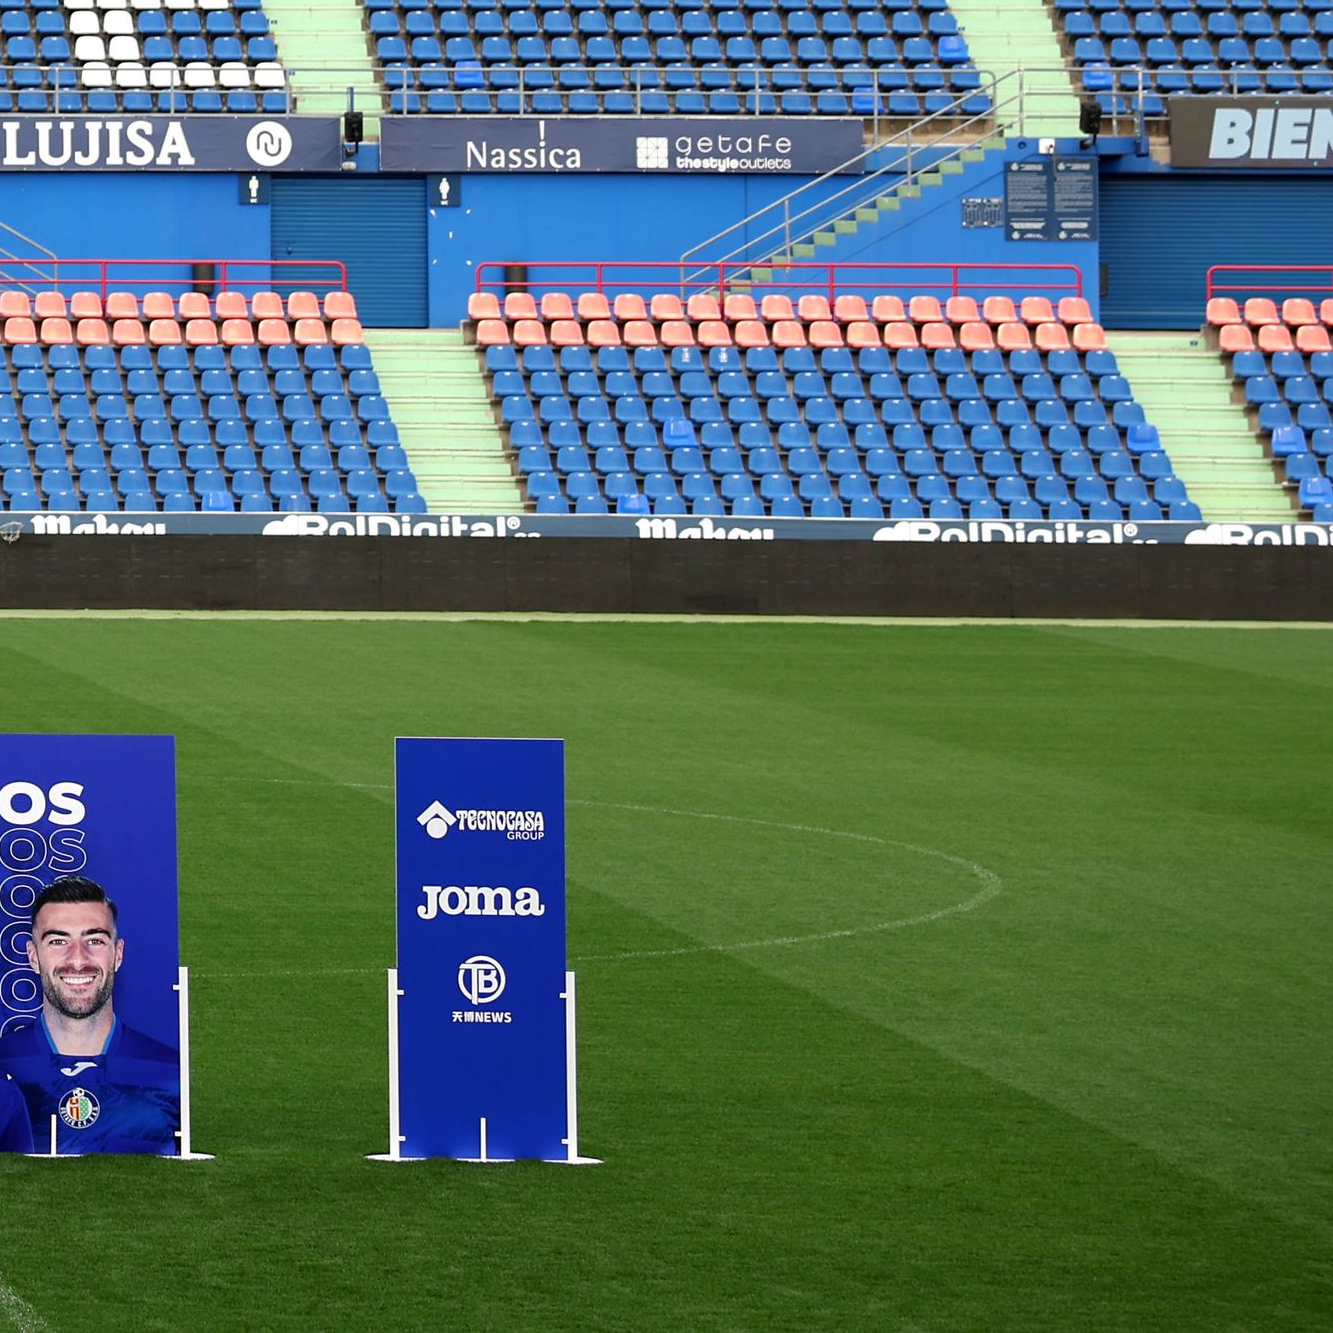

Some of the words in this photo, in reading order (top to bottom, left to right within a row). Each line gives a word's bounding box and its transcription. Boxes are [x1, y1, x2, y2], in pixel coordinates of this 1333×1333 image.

[2, 121, 196, 166] LUJISA
[466, 121, 582, 168] Nassica
[675, 134, 792, 154] getafe
[456, 810, 545, 832] TECNOCASA
[506, 830, 545, 842] GROUP
[416, 884, 545, 921] Joma
